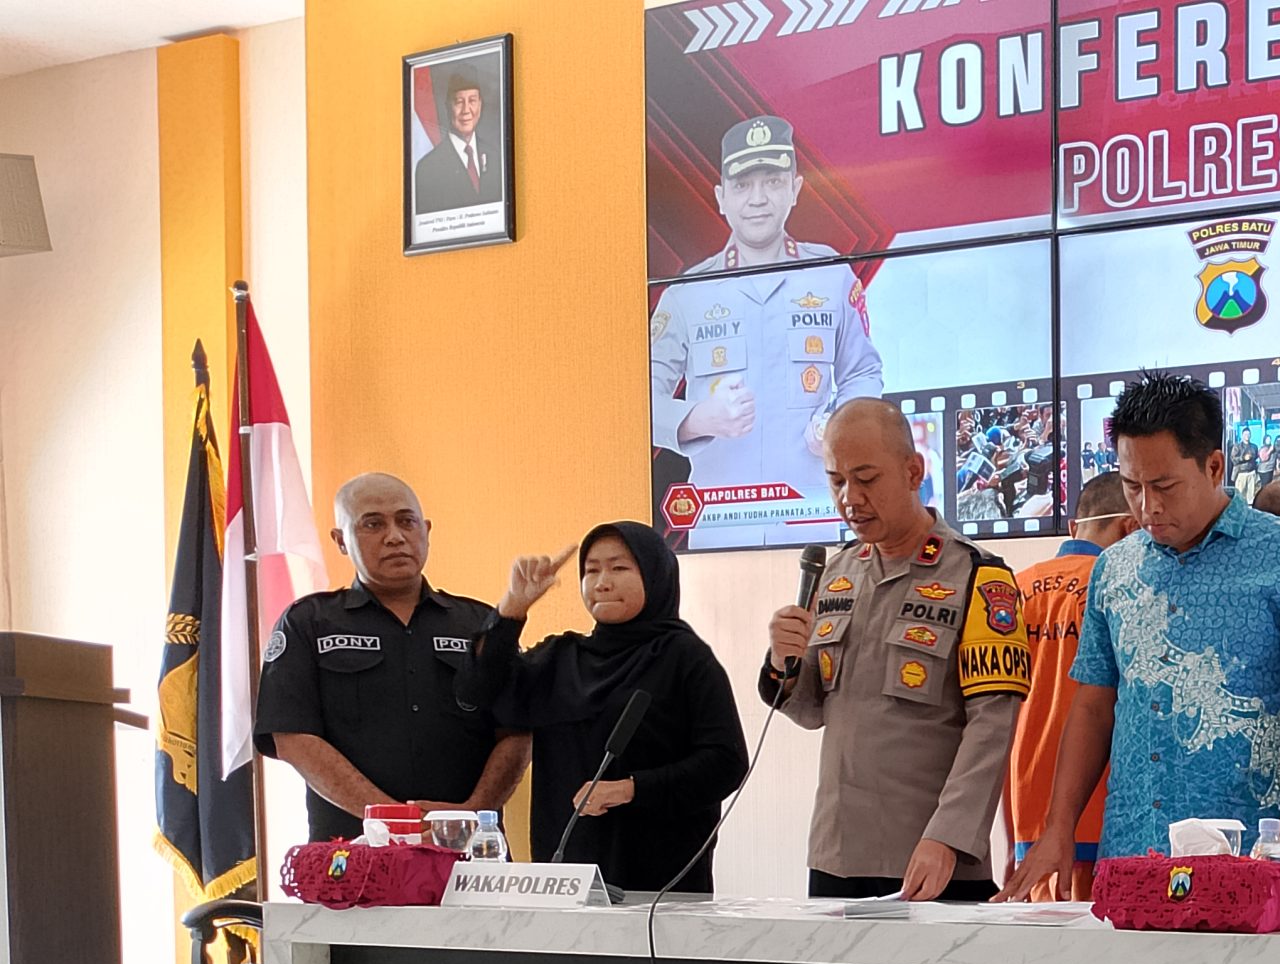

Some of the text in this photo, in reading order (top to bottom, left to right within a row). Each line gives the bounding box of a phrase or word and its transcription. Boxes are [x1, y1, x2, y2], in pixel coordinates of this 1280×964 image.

[1191, 221, 1273, 241] POLRES BATU
[1204, 240, 1261, 256] JAWA TIMUR
[791, 312, 833, 328] POLRI
[695, 321, 741, 341] ANDI Y
[703, 485, 789, 502] KAPOLRES BATU
[702, 512, 722, 522] AKBP
[723, 511, 741, 521] ANDI
[743, 509, 768, 520] YUDHA
[1022, 575, 1064, 602] LRES
[901, 602, 957, 626] POLRI
[322, 636, 374, 651] DONY
[959, 645, 1002, 681] WAKA
[454, 874, 582, 896] WAKAPOLRES
